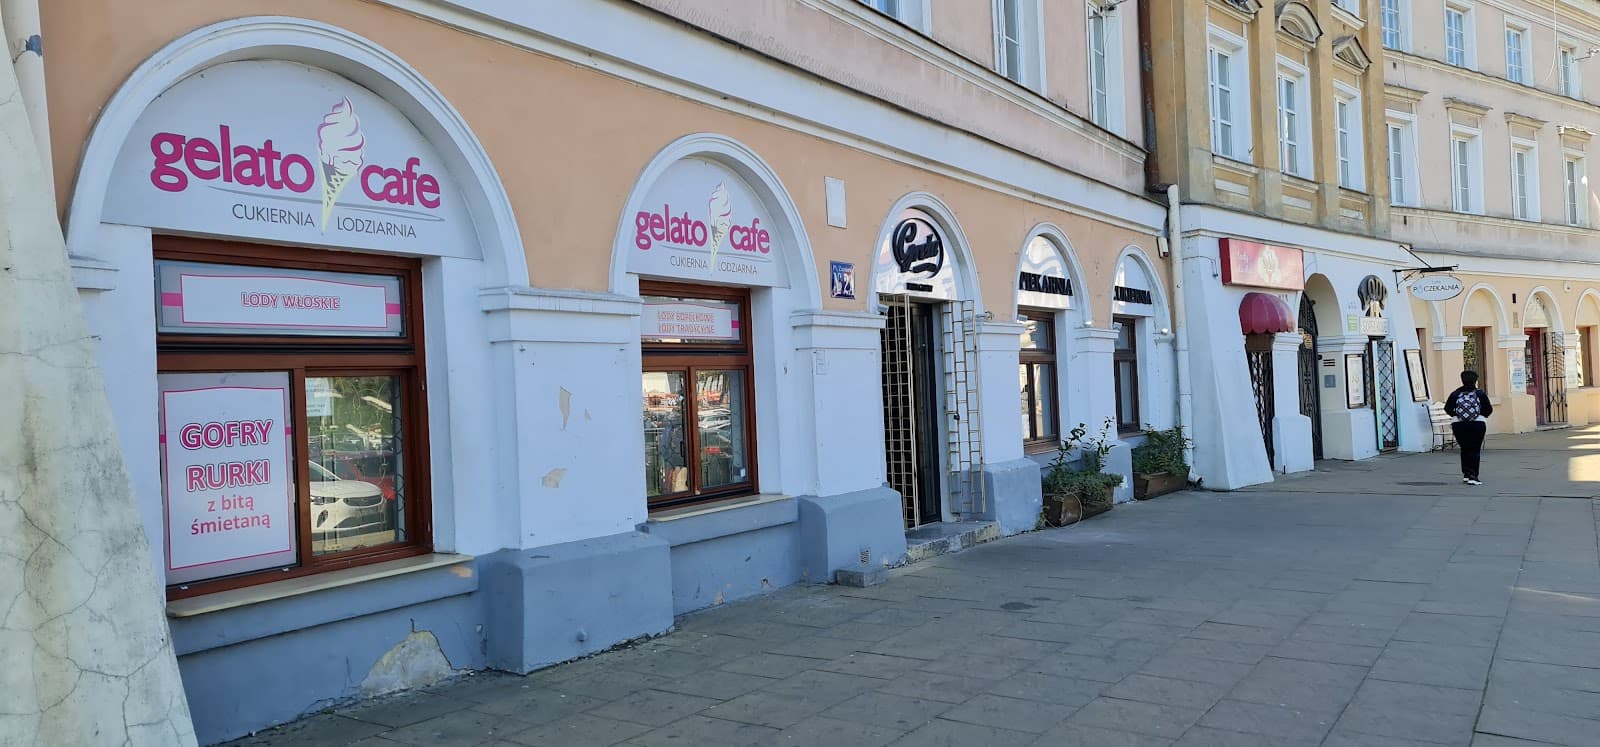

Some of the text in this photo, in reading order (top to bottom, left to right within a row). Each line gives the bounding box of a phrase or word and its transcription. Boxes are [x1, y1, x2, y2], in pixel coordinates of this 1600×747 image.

[150, 124, 441, 209] gelato cafe
[232, 203, 417, 239] CUKIERNIA LODZIARNIA
[635, 203, 770, 254] gelato cafe
[670, 255, 758, 275] CUKIERNIA LODZIARNIA
[1019, 271, 1074, 296] PIEKARNIA
[241, 292, 341, 310] LODY WŁOSKIE
[180, 420, 273, 450] GOFRY
[186, 460, 271, 492] RURKI
[207, 494, 254, 512] z bitą
[191, 513, 271, 536] śmietaną
